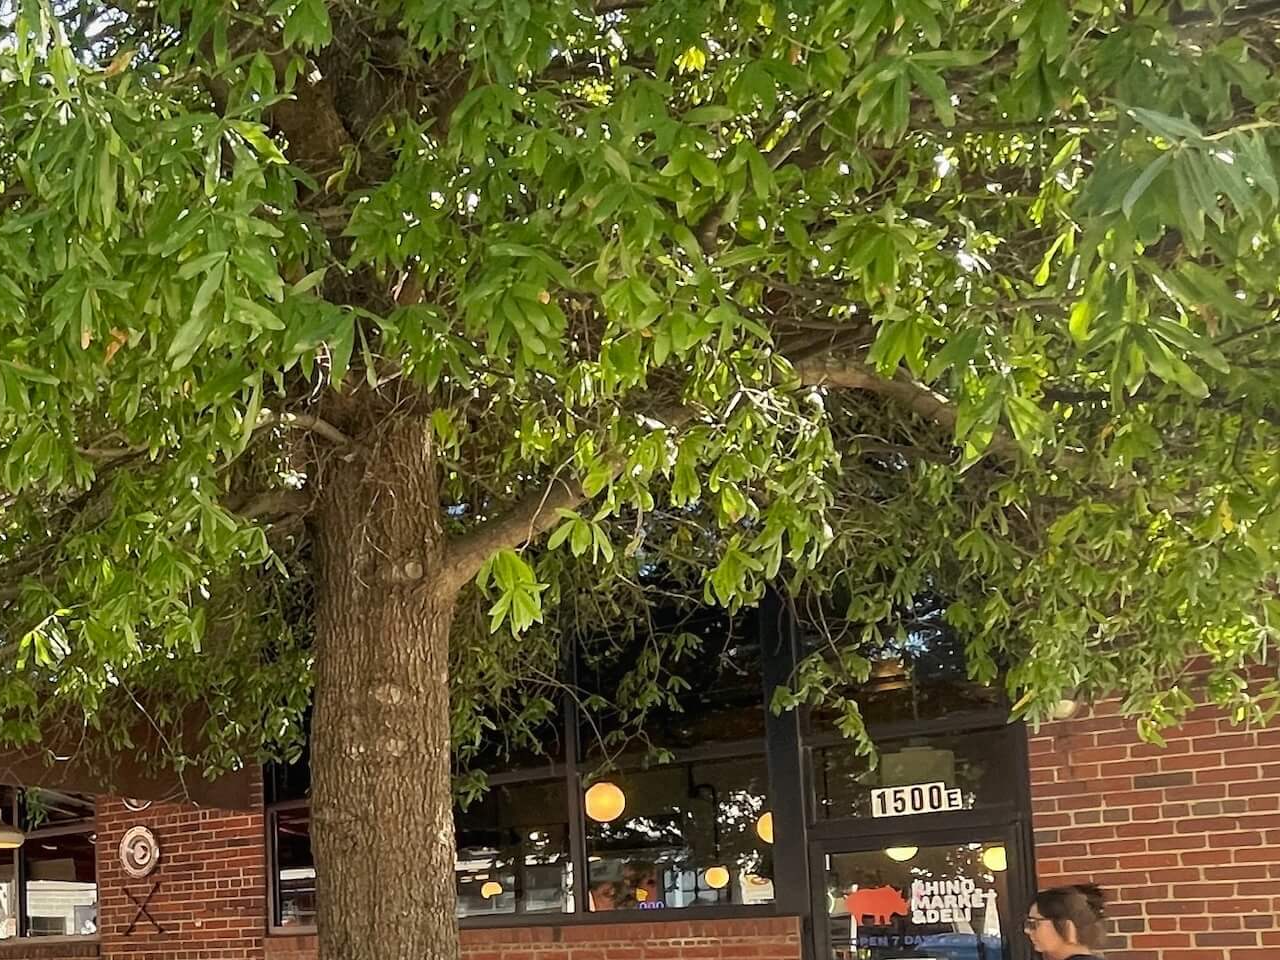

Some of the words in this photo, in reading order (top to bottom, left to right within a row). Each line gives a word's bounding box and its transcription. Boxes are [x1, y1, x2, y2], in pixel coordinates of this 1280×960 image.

[911, 879, 976, 896] RHINO
[911, 888, 998, 912] MARKET
[891, 935, 901, 946] 7
